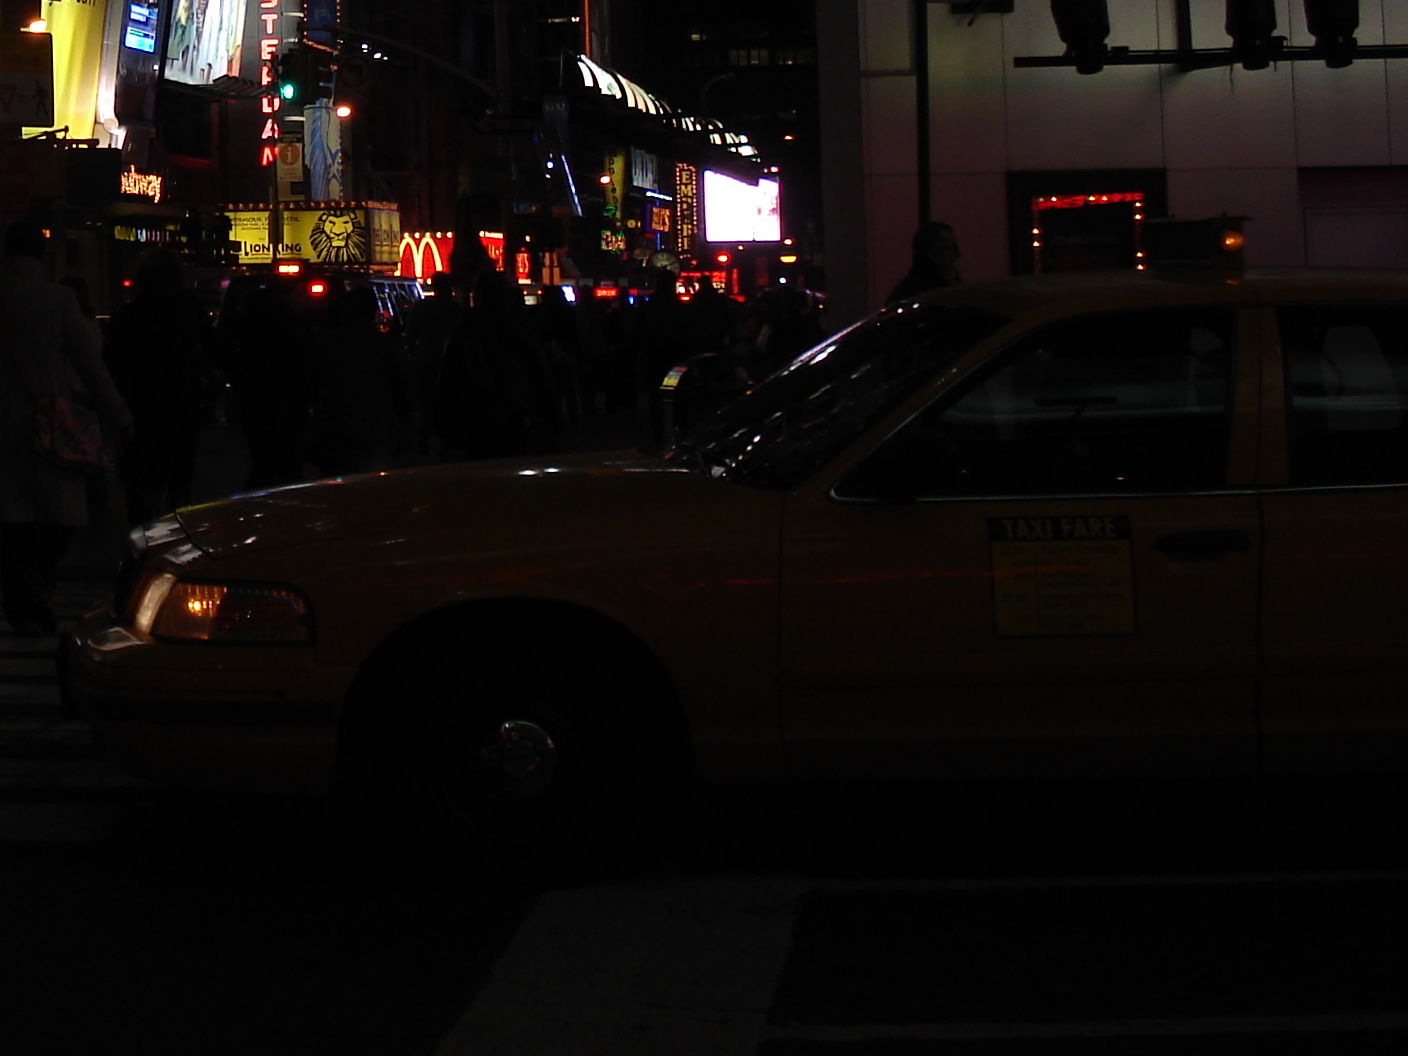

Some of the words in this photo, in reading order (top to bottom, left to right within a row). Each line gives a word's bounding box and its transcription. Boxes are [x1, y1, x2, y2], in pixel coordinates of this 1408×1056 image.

[275, 243, 302, 257] ING
[1002, 519, 1053, 540] TAXI
[1060, 517, 1117, 539] FARE
